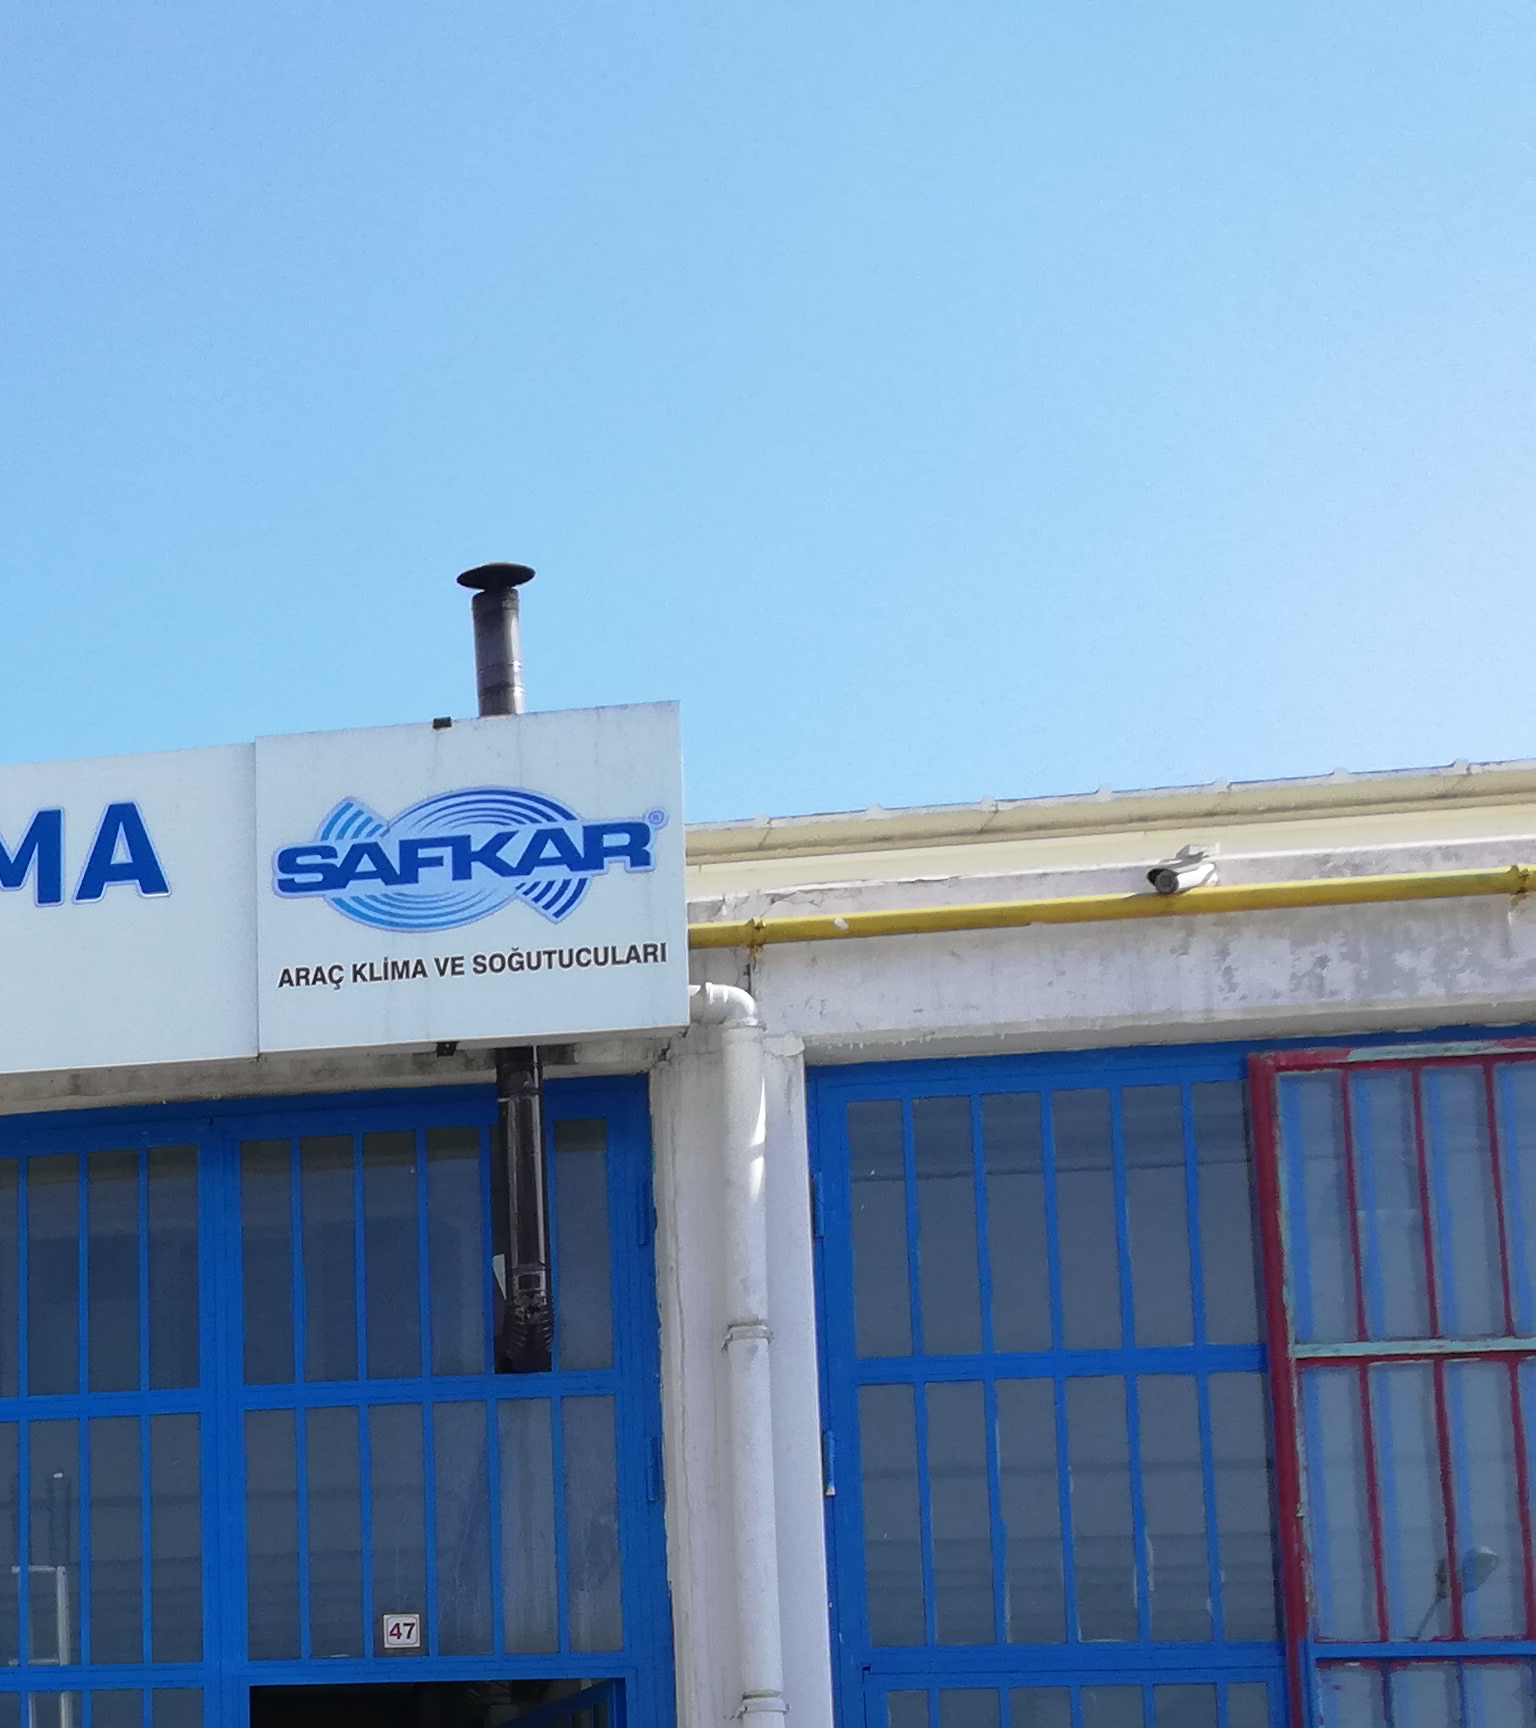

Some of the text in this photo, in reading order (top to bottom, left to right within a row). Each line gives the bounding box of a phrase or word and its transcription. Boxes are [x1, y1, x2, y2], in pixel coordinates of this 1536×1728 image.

[277, 822, 651, 893] SAFKAR
[278, 942, 667, 991] ARAÇ KLİMA VE SOĞUTUCULARI
[389, 1622, 415, 1640] 47
